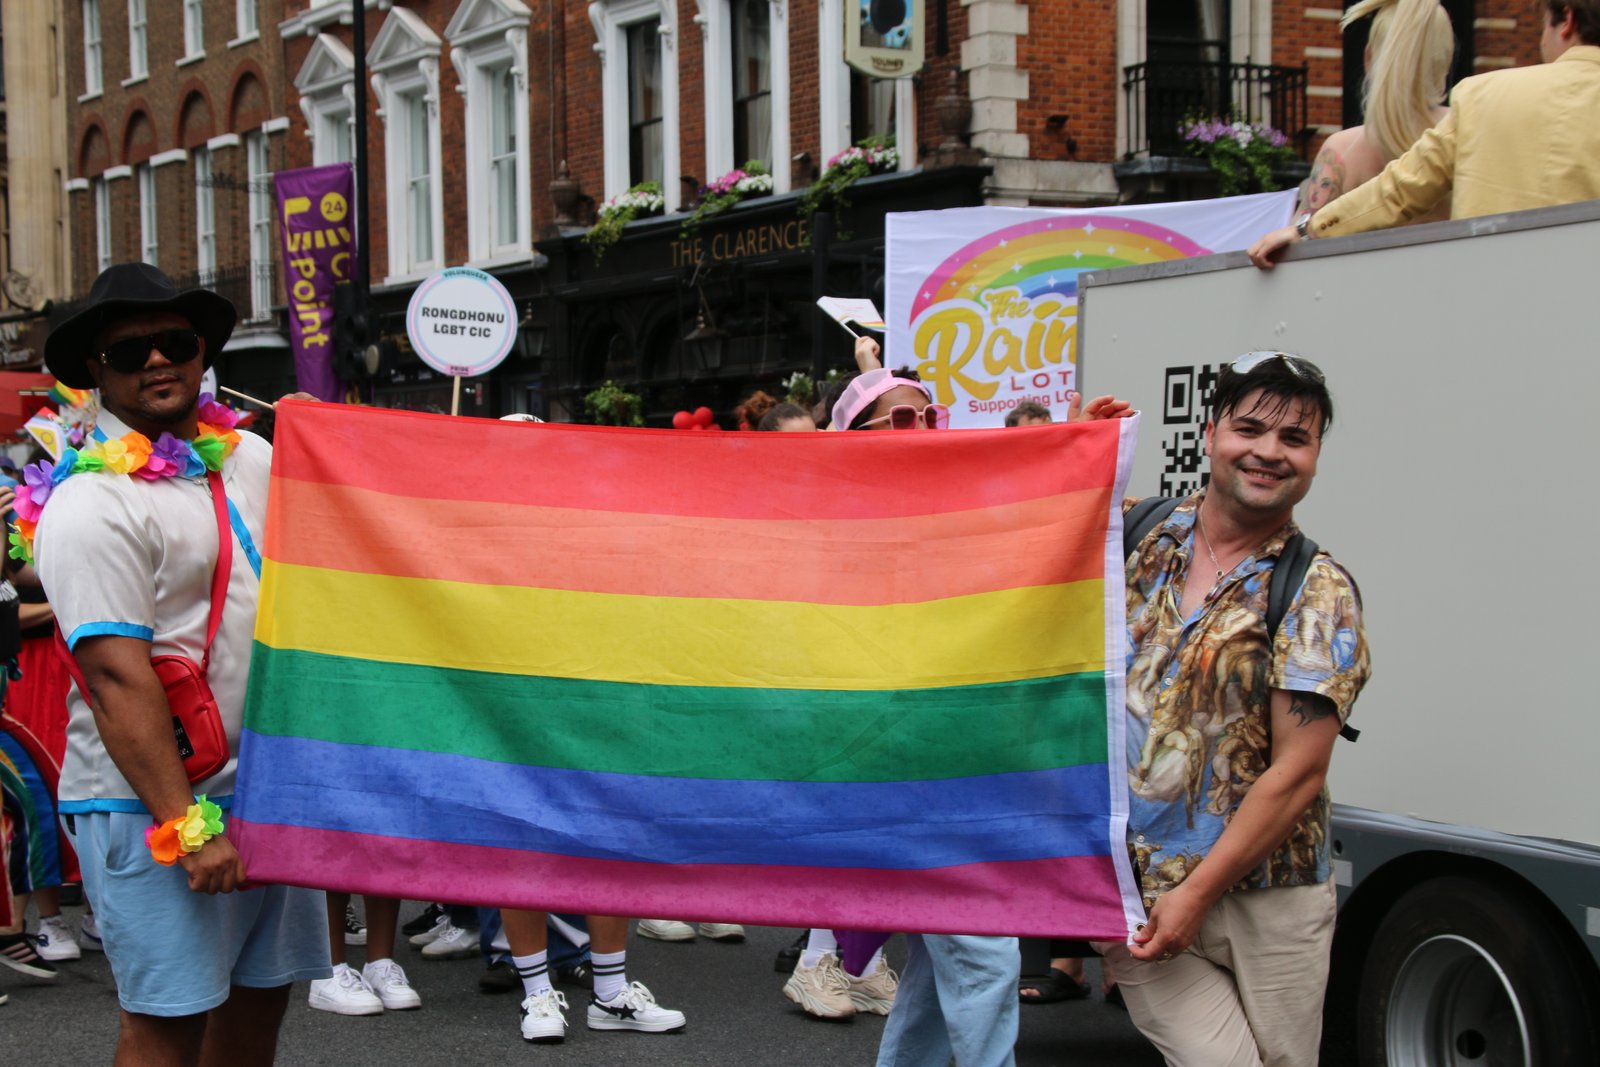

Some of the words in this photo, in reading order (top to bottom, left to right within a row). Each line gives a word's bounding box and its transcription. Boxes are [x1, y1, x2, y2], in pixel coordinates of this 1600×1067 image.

[324, 200, 344, 215] 24
[670, 238, 704, 266] THE
[712, 219, 808, 260] CLARENCE
[290, 257, 329, 349] Point
[422, 307, 505, 324] RONGDHONU
[985, 289, 1031, 326] The
[433, 324, 466, 336] LGBT
[469, 327, 491, 338] CIC
